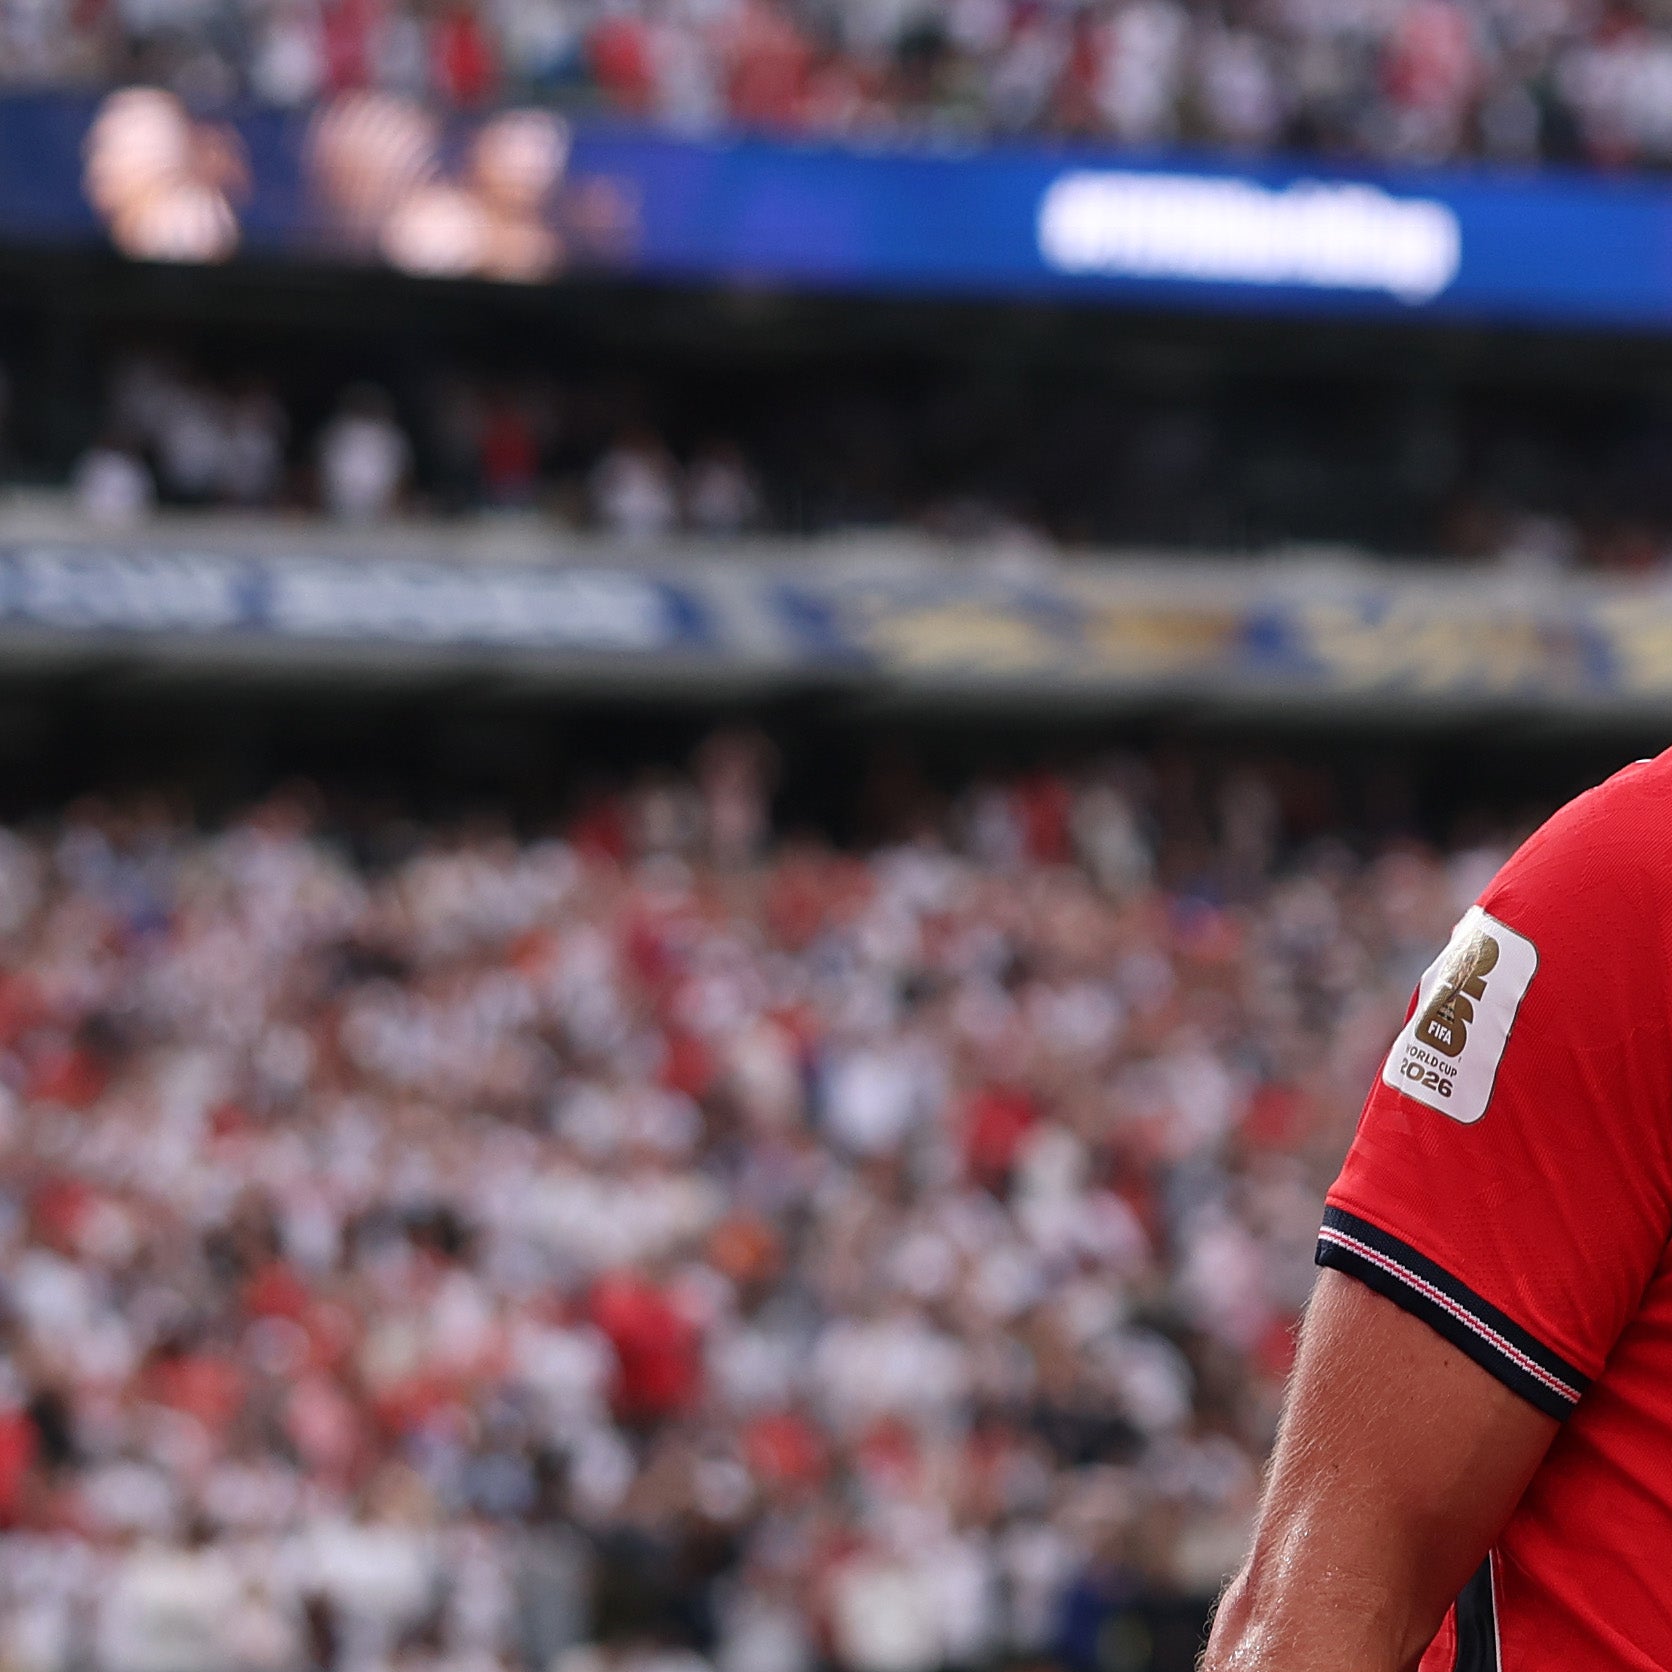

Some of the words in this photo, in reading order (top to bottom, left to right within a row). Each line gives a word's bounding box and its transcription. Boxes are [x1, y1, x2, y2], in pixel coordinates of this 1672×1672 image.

[1428, 1021, 1452, 1045] FIFA
[1400, 1057, 1454, 1098] 2026
[1438, 1061, 1458, 1078] CUP
